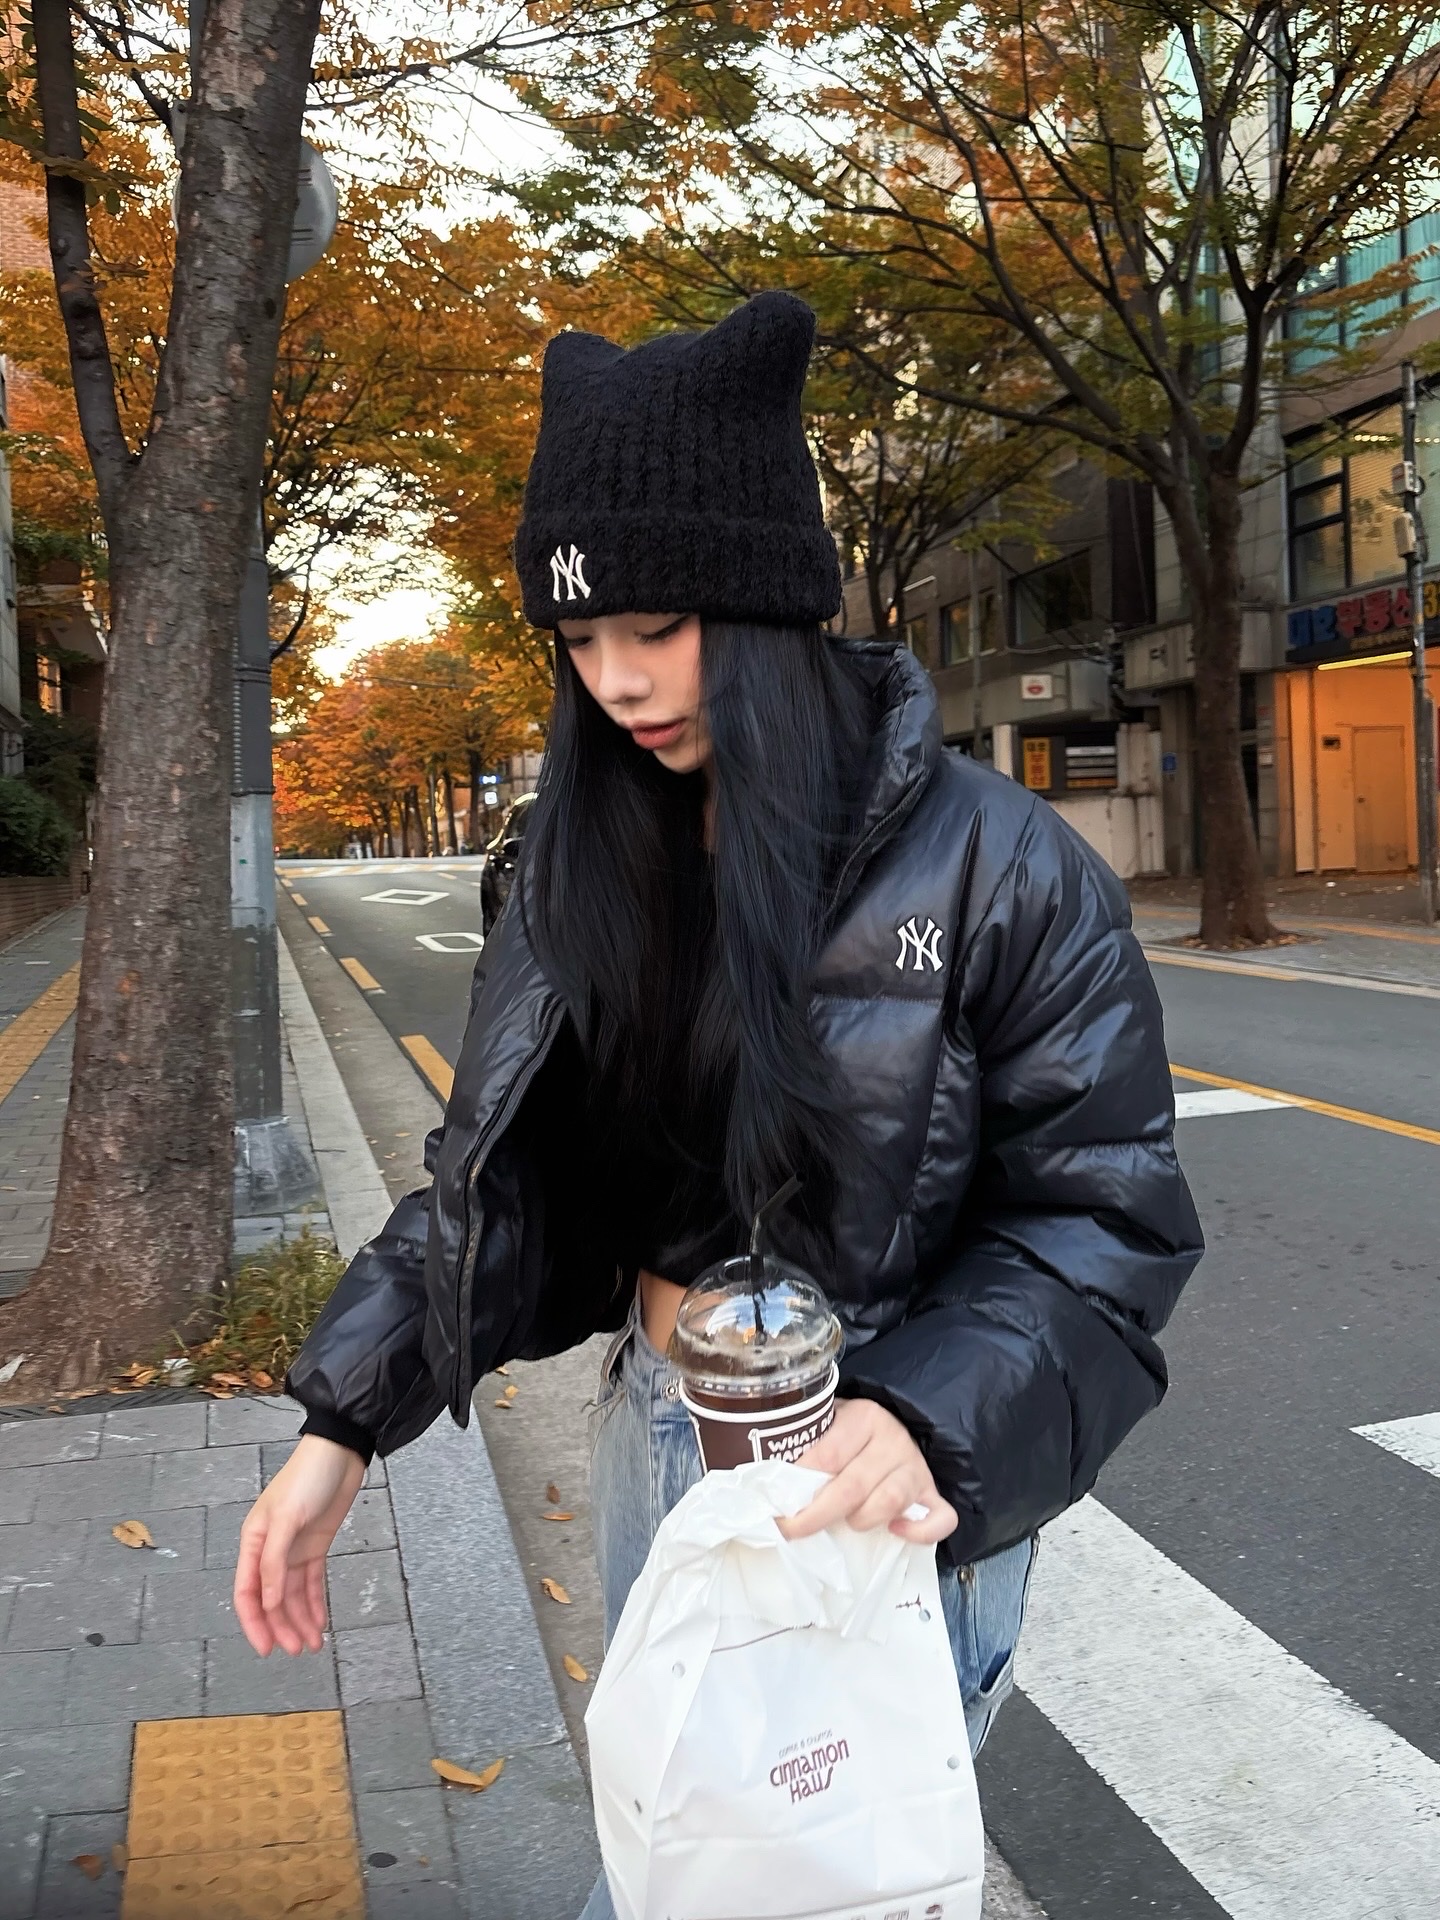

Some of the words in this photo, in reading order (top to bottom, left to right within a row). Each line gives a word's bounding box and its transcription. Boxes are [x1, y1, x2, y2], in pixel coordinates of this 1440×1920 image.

[549, 543, 591, 602] NY
[895, 916, 943, 972] NY
[767, 1424, 818, 1453] WHAT
